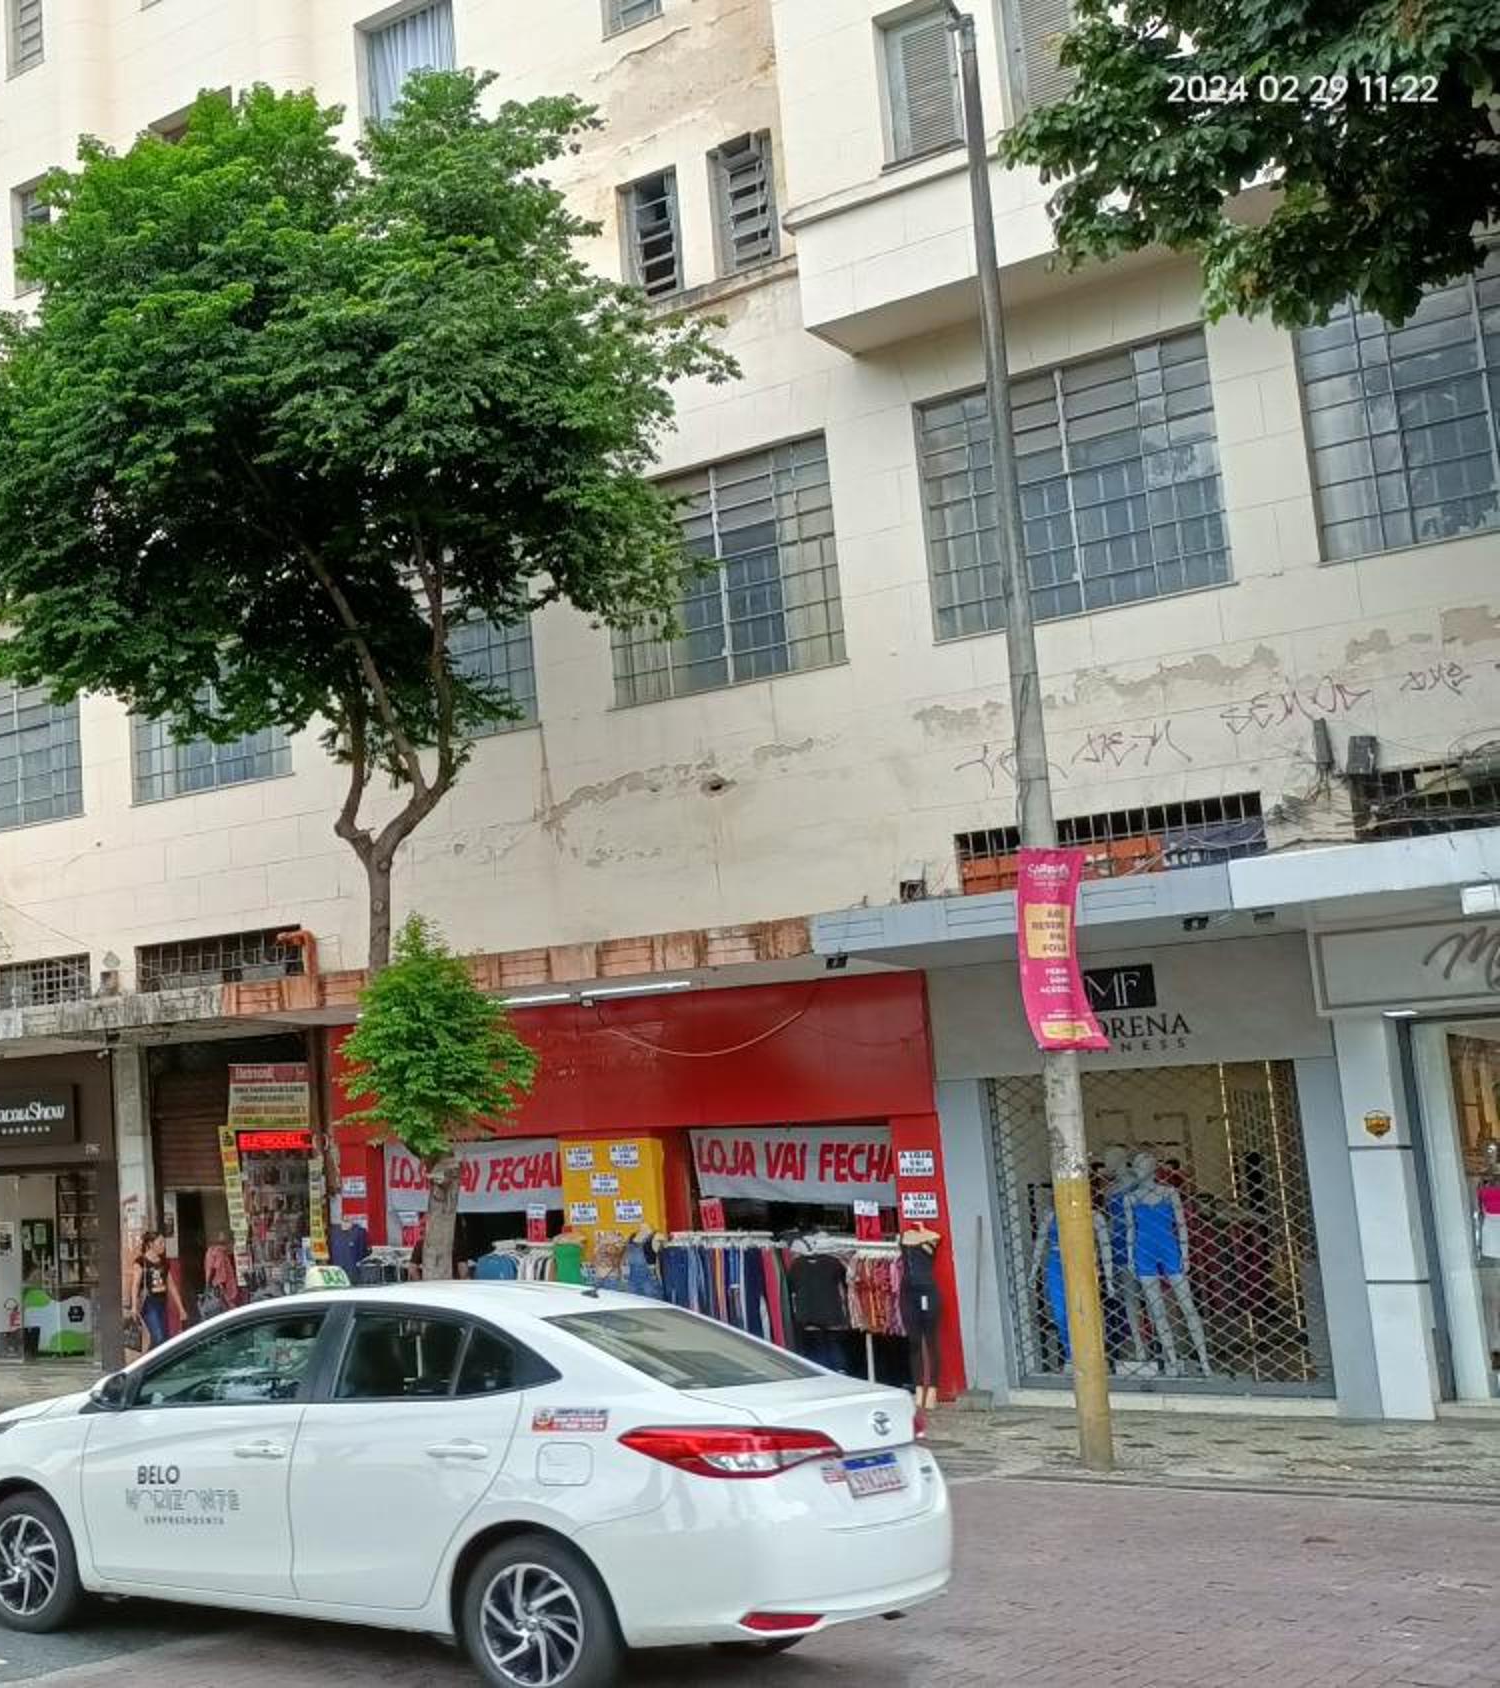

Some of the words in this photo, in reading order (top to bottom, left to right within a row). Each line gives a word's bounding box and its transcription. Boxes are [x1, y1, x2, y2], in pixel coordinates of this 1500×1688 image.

[1084, 970, 1142, 1007] MF
[388, 1155, 431, 1191] LOJ
[458, 1159, 481, 1193] AI
[698, 1137, 757, 1178] LOJA
[765, 1139, 809, 1182] VAI
[818, 1141, 896, 1183] FECHA
[136, 1464, 181, 1485] BELO
